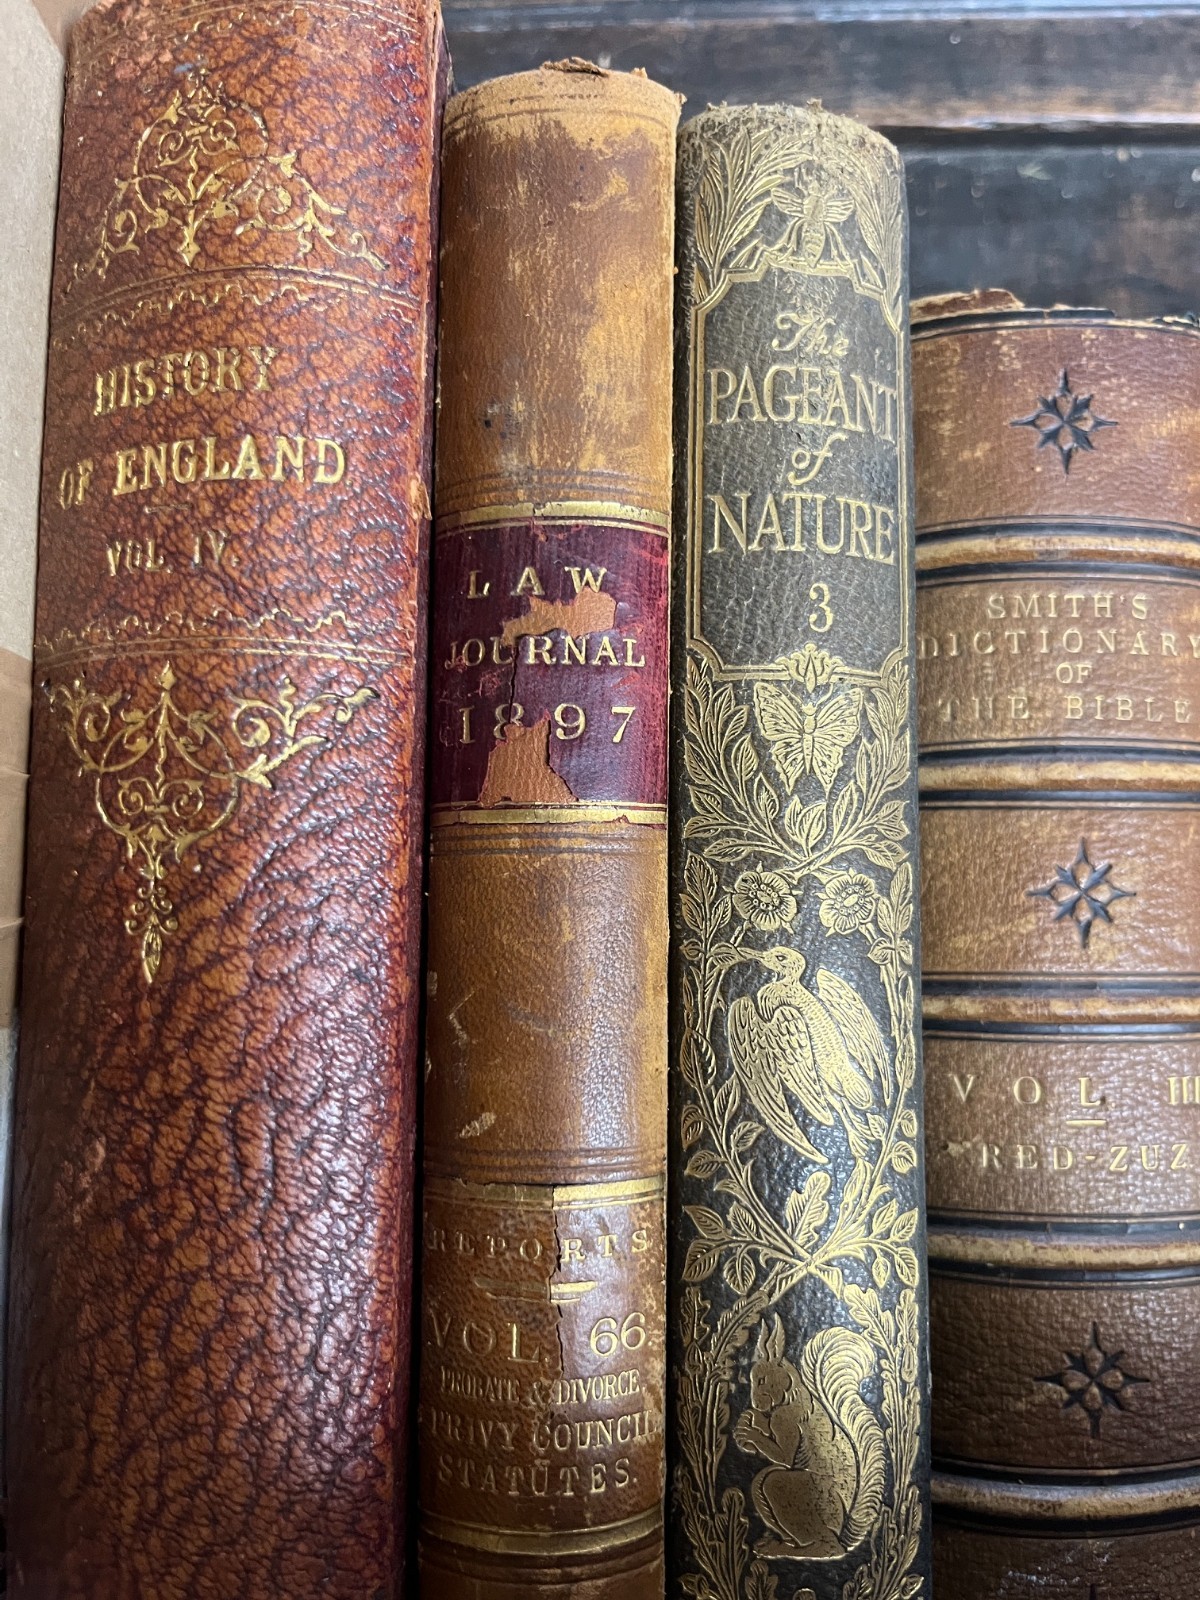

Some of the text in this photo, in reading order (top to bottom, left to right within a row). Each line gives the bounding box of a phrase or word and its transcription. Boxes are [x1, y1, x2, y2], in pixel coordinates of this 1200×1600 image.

[771, 312, 849, 356] The
[93, 346, 279, 416] HISTORY
[706, 365, 897, 444] PAGEANT
[786, 432, 848, 486] of
[57, 459, 94, 510] OF
[707, 493, 897, 565] NATURE
[467, 566, 607, 600] LAW
[808, 582, 834, 633] 3
[987, 591, 1150, 620] SMITH'S
[444, 635, 646, 670] JOURNAL
[917, 627, 1200, 661] DICTIONARY
[1056, 661, 1092, 684] OF
[458, 702, 636, 745] 1897
[937, 693, 1192, 723] THE BIBLE
[1167, 1076, 1200, 1106] III
[981, 1143, 1188, 1173] RED-ZUZ
[428, 1229, 649, 1264] REPORTS
[440, 1365, 520, 1403] PROBATE
[530, 1378, 551, 1406] &
[430, 1405, 521, 1452] PRIVY
